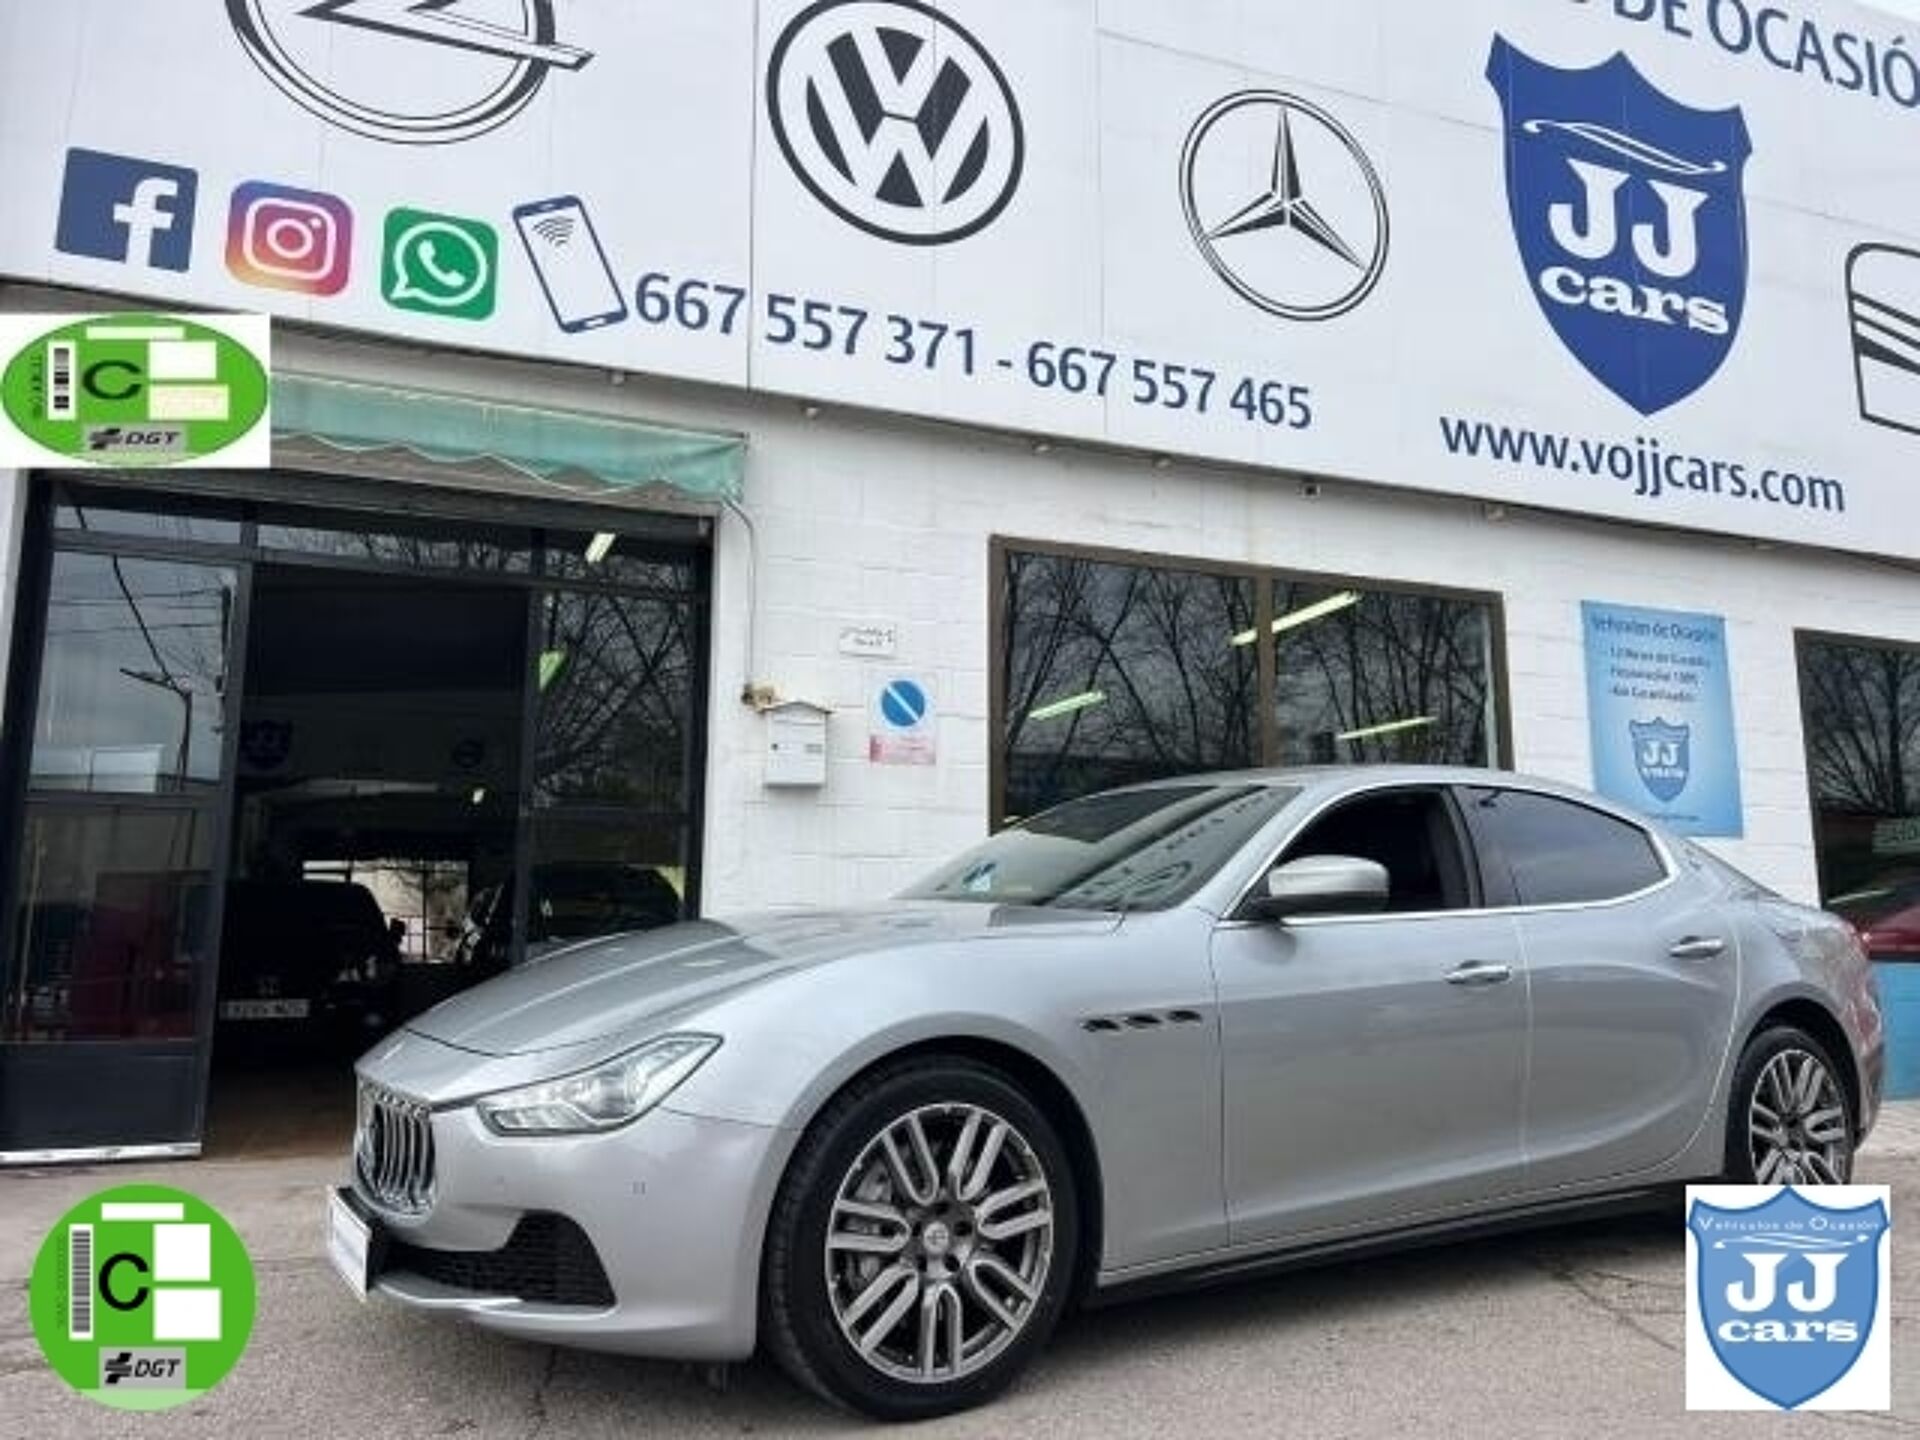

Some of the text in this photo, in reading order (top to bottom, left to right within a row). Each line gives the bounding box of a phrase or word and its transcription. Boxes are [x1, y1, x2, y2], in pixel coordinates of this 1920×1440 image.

[1548, 158, 1710, 278] JJ
[1539, 266, 1729, 335] cars
[635, 272, 746, 335] 667
[765, 294, 869, 356] 557
[885, 315, 976, 376] 371
[1027, 341, 1118, 397] 667
[1132, 359, 1216, 413] 557
[1230, 377, 1313, 430] 465
[1440, 415, 1846, 512] www.vojjcars.com
[1642, 739, 1680, 767] JJ
